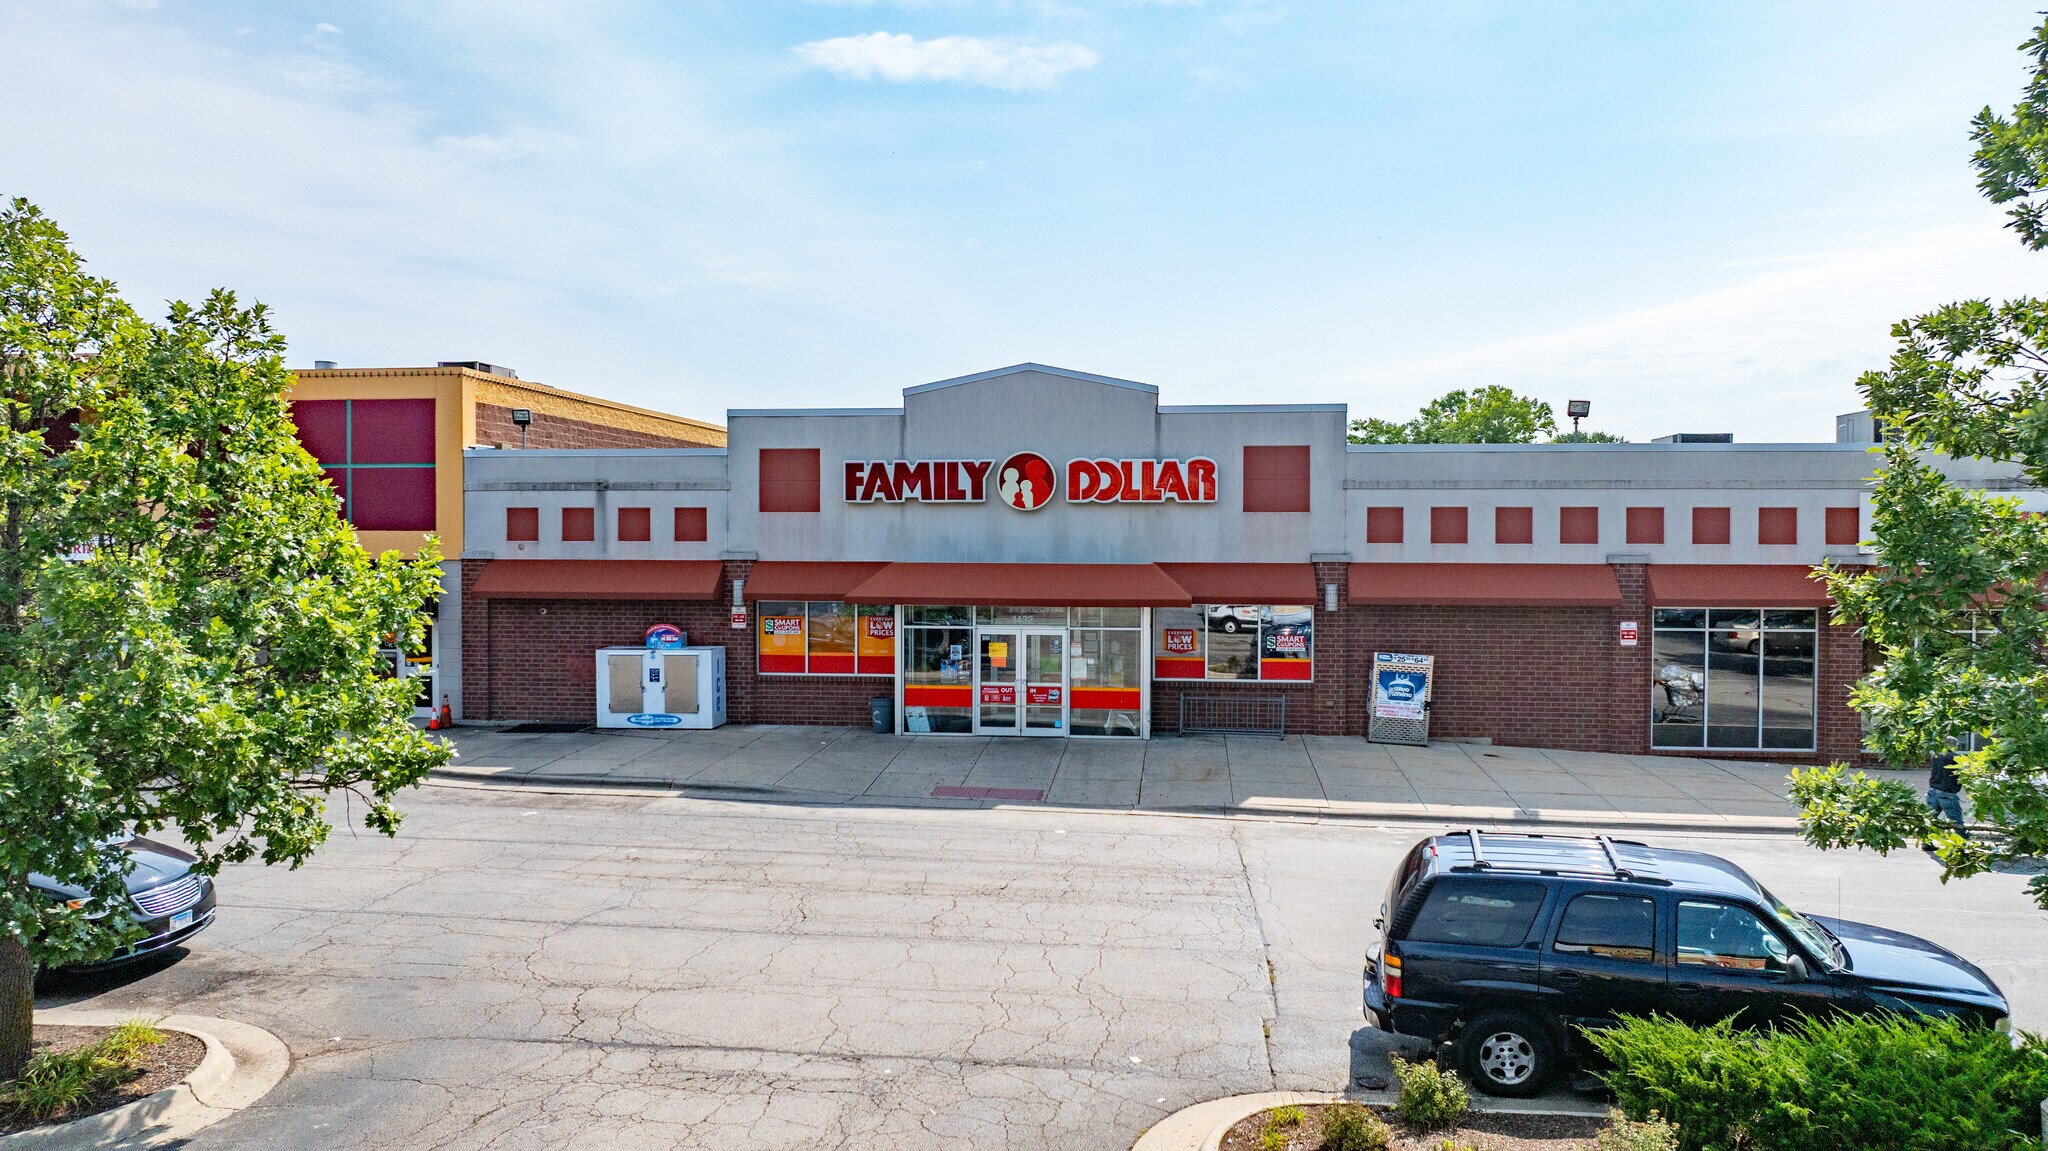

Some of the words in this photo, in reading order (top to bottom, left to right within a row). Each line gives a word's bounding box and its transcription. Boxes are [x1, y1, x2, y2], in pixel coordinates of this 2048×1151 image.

[844, 460, 996, 502] FAMILY
[1066, 457, 1218, 503] DOLLAR
[1013, 615, 1033, 624] 1432
[870, 621, 893, 630] LOW
[1168, 635, 1192, 643] LOW
